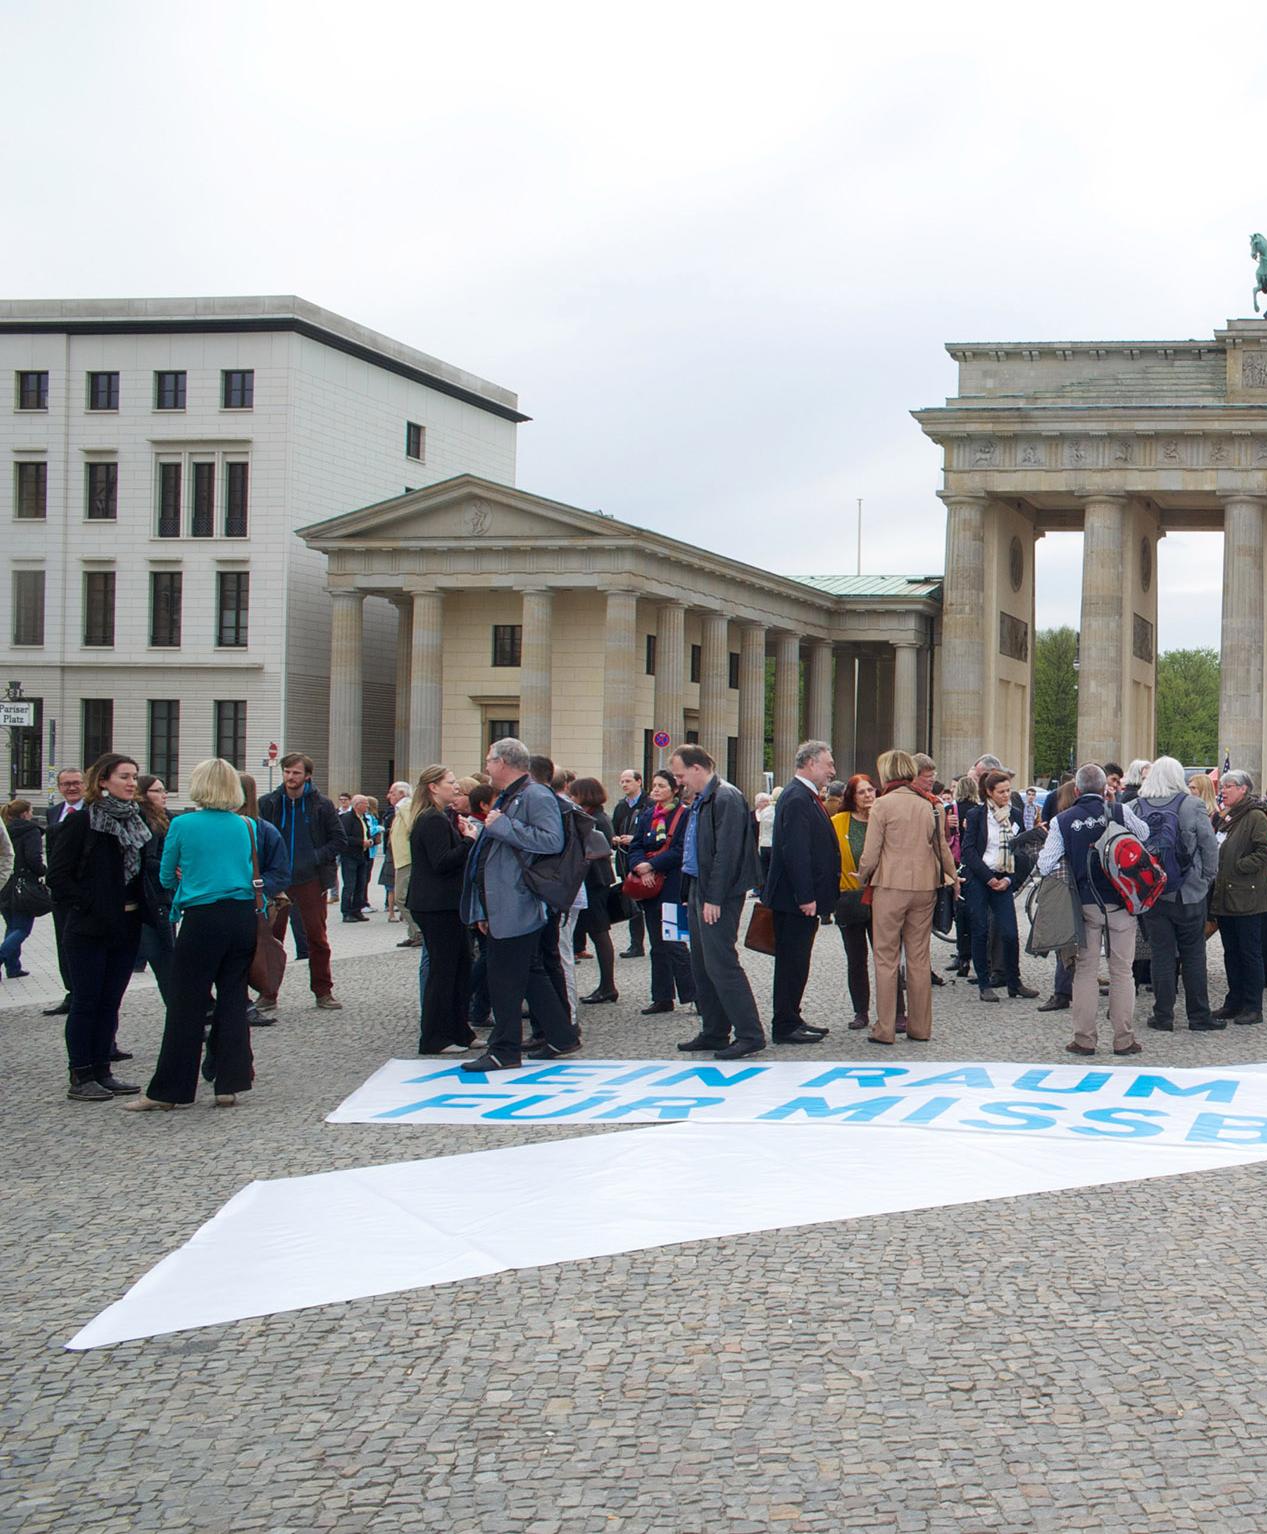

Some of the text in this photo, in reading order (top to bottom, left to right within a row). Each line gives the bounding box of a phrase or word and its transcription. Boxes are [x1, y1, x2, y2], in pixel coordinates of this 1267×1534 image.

[0, 704, 29, 714] Pariser
[3, 714, 25, 724] Platz
[800, 1066, 1239, 1103] RAUM
[370, 1088, 726, 1121] FÜR
